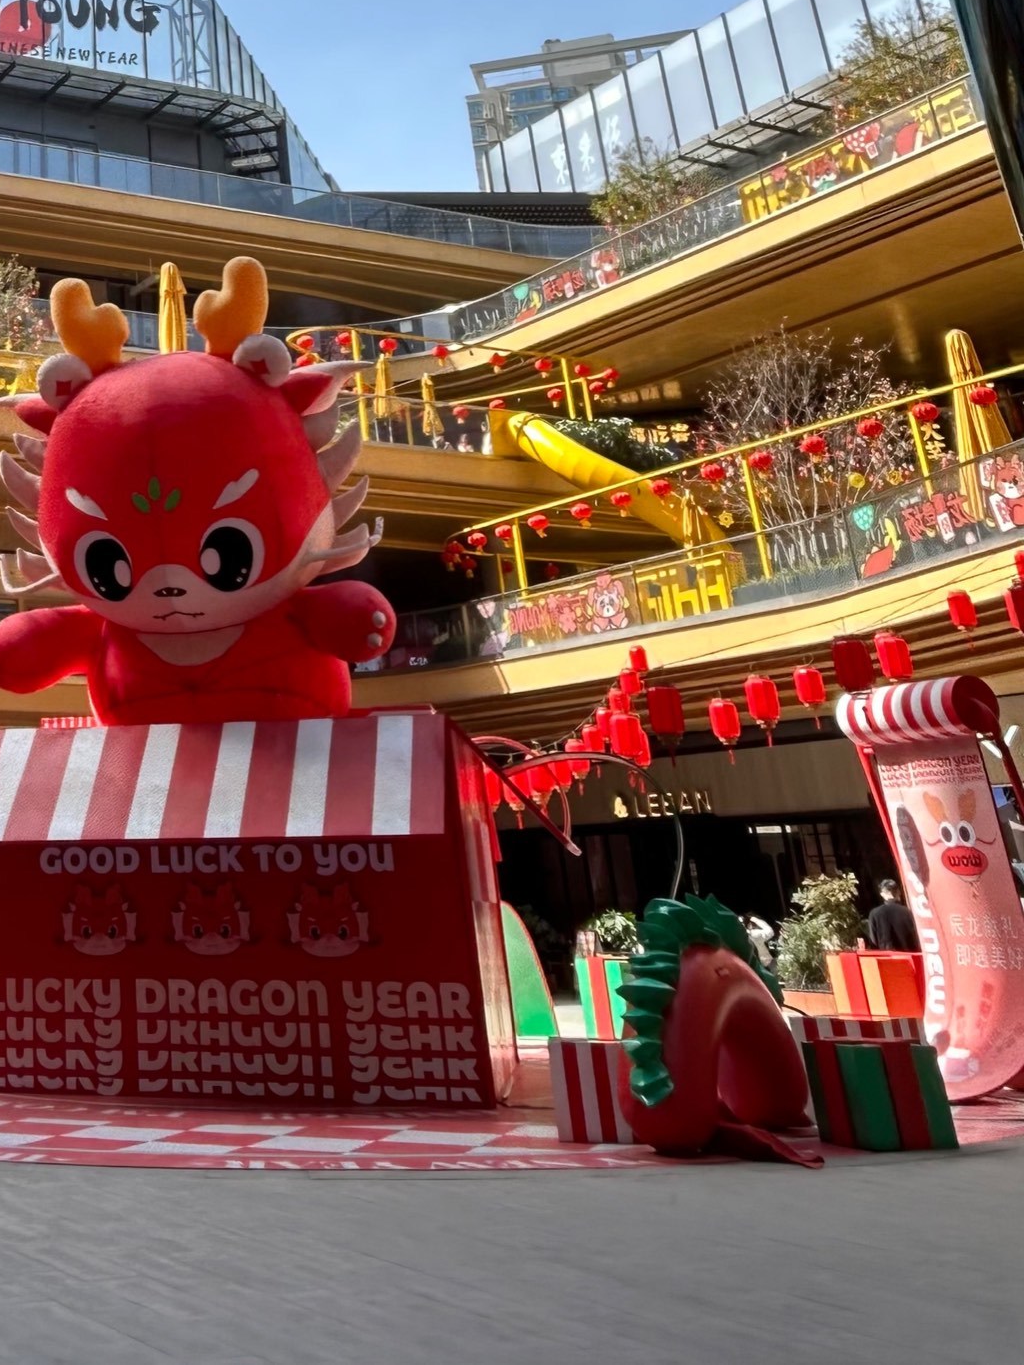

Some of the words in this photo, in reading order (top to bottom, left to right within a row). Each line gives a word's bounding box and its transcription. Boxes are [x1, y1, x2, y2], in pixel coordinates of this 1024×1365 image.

[56, 47, 90, 62] NEW
[95, 50, 139, 66] YEAR
[39, 846, 140, 875] GOOD
[151, 844, 242, 874] LUCK
[251, 844, 301, 873] TO
[313, 842, 395, 876] YOU
[135, 978, 328, 1016] DRAGON
[342, 980, 473, 1022] YEAR
